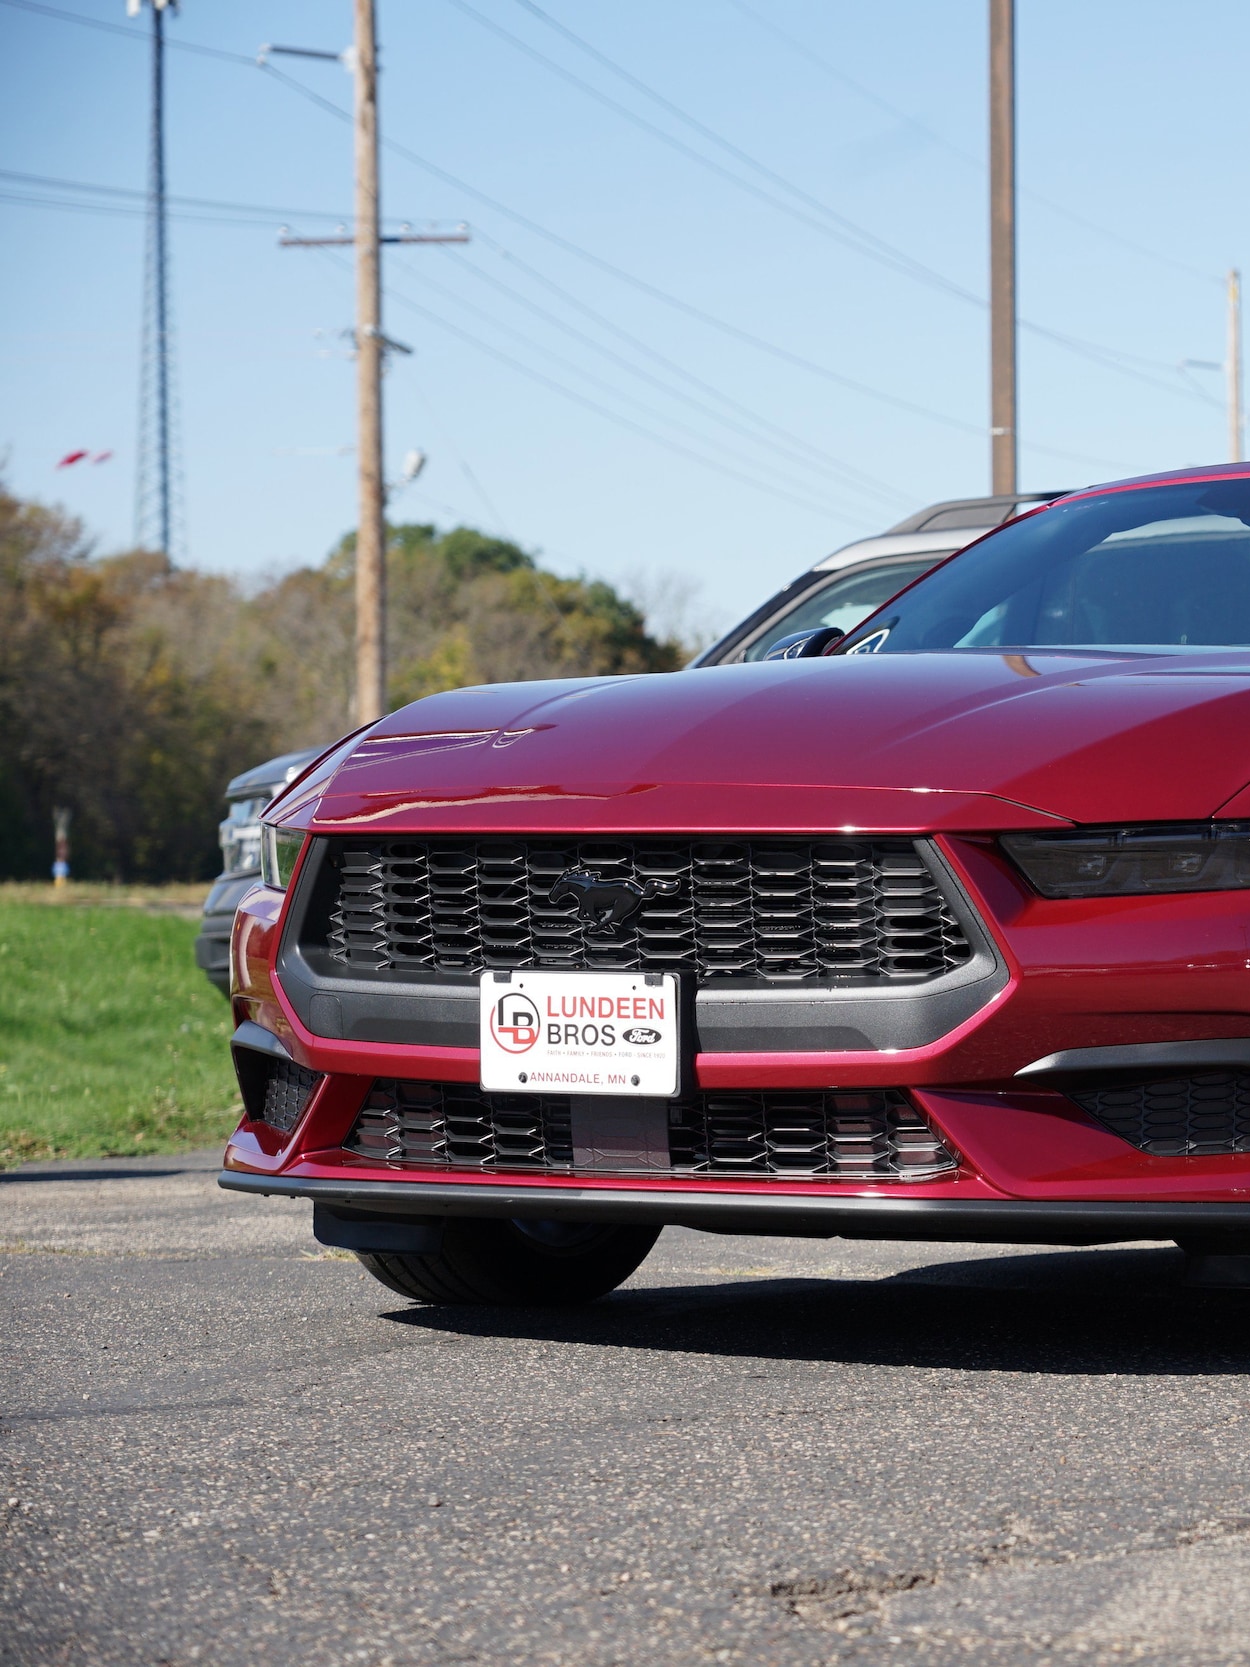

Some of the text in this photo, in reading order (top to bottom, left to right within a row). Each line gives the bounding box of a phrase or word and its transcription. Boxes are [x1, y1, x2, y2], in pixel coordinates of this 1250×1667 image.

[547, 995, 665, 1020] LUNDEEN
[547, 1023, 616, 1046] BROS
[627, 1028, 657, 1044] Ford
[529, 1071, 626, 1085] ANNANDALE, MN
